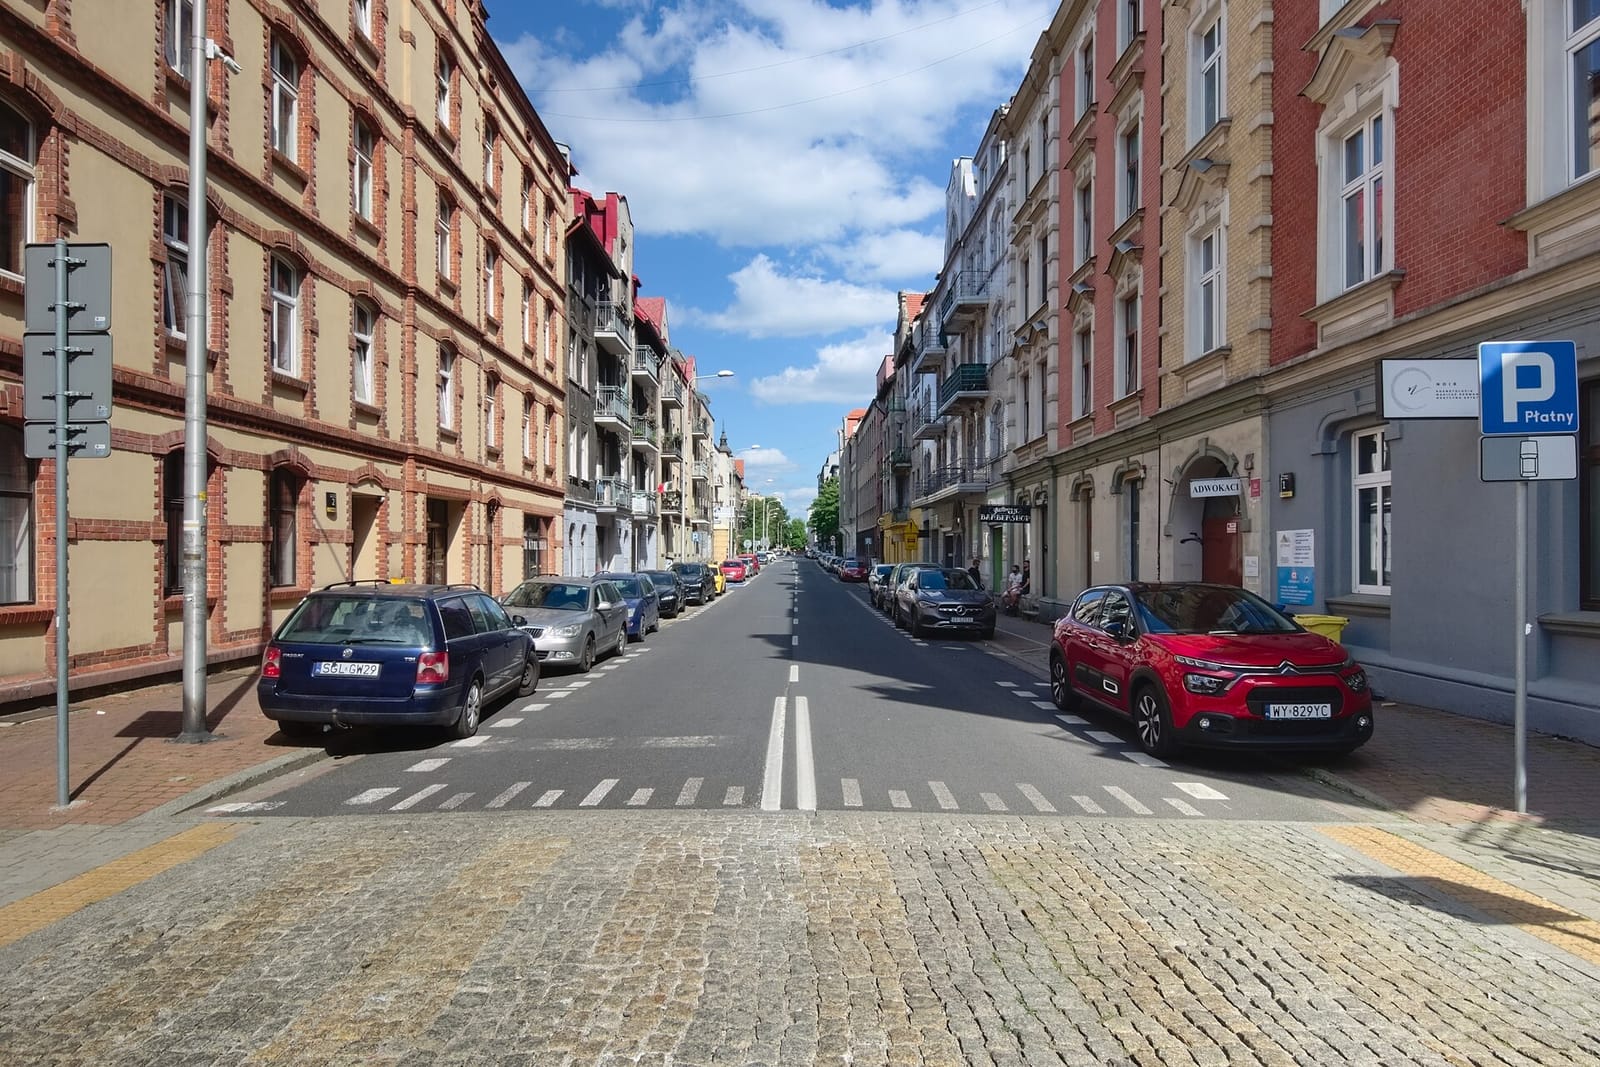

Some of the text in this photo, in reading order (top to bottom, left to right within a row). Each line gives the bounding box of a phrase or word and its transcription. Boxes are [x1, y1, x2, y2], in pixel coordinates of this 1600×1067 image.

[1501, 352, 1555, 422] P
[1525, 410, 1574, 425] Płatny
[1192, 483, 1239, 494] ADWOKACI
[980, 513, 1030, 521] BARBERSHOP
[322, 663, 377, 674] SGL GW29
[1272, 705, 1328, 717] WY 829YC
